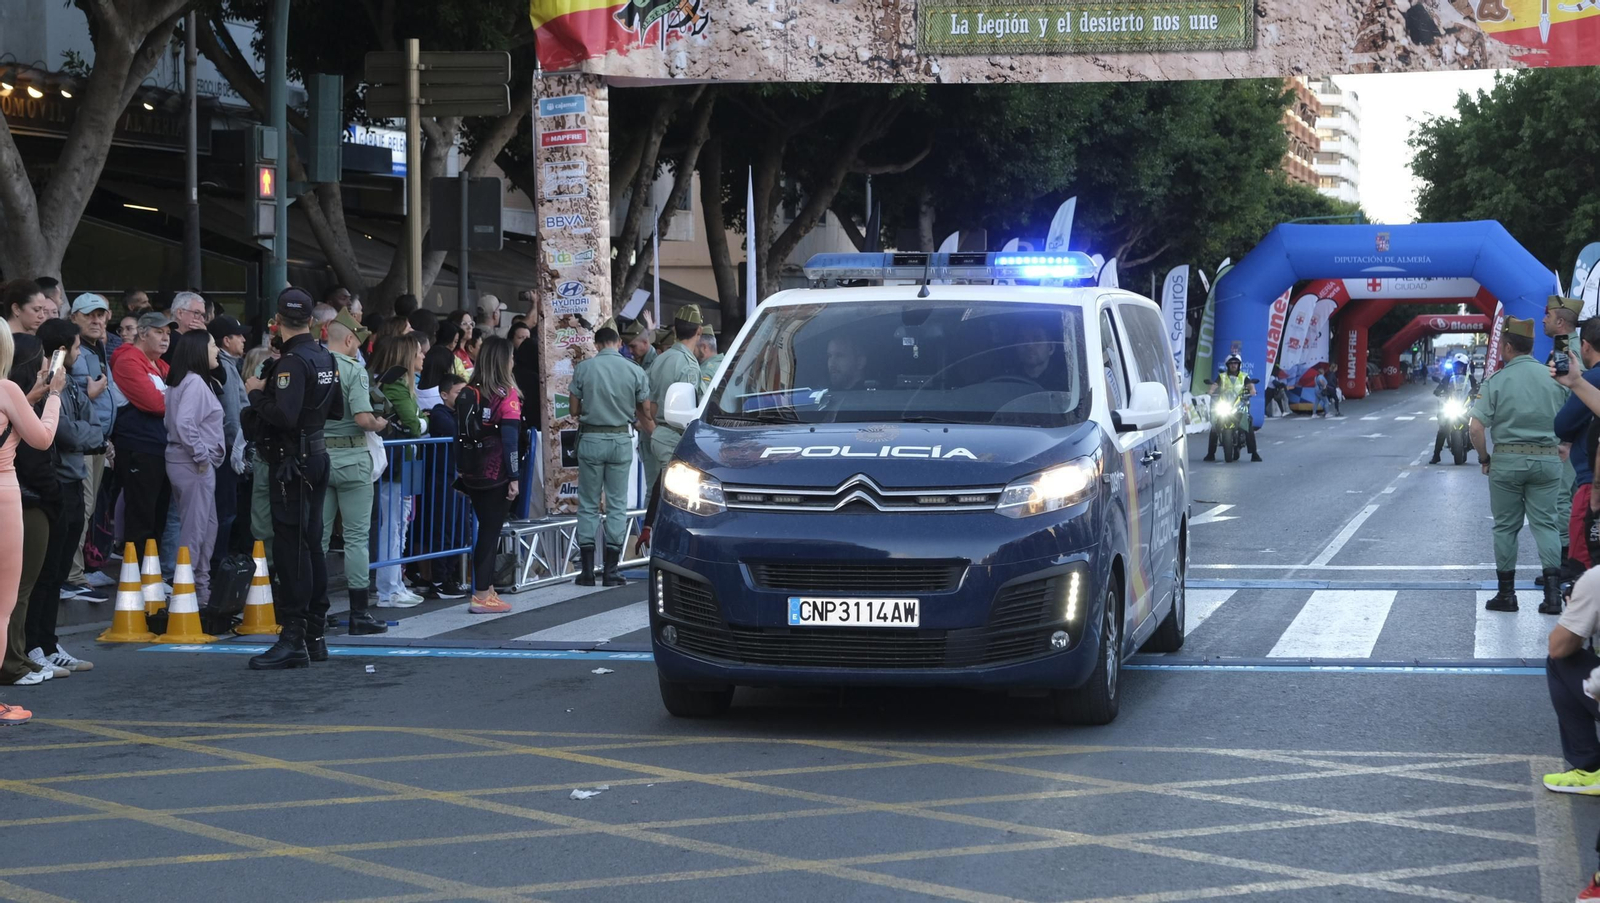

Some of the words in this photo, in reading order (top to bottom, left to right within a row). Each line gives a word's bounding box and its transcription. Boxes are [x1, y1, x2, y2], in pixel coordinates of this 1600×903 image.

[950, 13, 970, 35] La
[977, 12, 1030, 38] Legión
[1038, 16, 1049, 38] y
[1057, 12, 1071, 33] el
[1079, 11, 1144, 32] desierto
[1153, 14, 1180, 31] nos
[1189, 13, 1219, 30] une
[550, 133, 583, 142] MAPFRE
[546, 215, 584, 228] BBVA
[1334, 255, 1383, 264] DIPUTACIÓN
[1385, 256, 1396, 264] DE
[1398, 255, 1432, 264] ALMERÍA
[1394, 282, 1428, 291] CIUDAD
[552, 298, 590, 307] HYUNDAI
[1171, 274, 1185, 342] Seguros
[1450, 321, 1484, 330] Blanes
[1347, 330, 1357, 379] MAPFRE
[759, 445, 977, 460] POLICÍA
[800, 601, 916, 623] CNP3114AW
